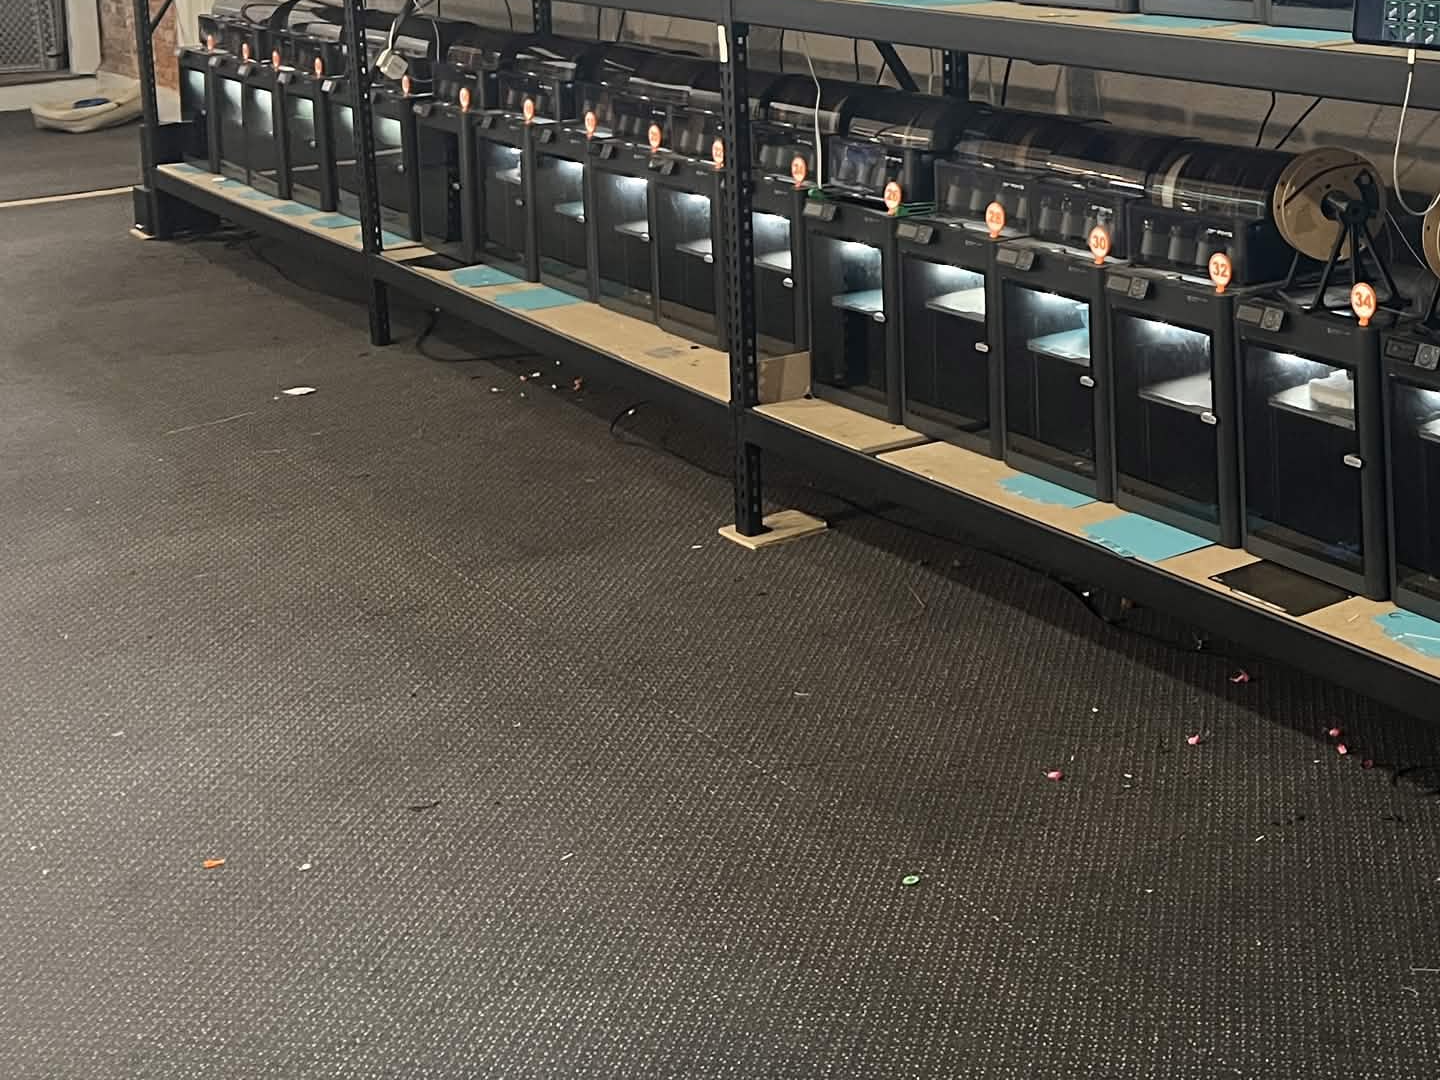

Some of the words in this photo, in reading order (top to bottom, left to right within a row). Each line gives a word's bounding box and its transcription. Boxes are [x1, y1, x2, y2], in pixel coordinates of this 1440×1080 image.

[1093, 235, 1106, 251] 30
[1212, 262, 1228, 279] 32
[1355, 291, 1373, 310] 34
